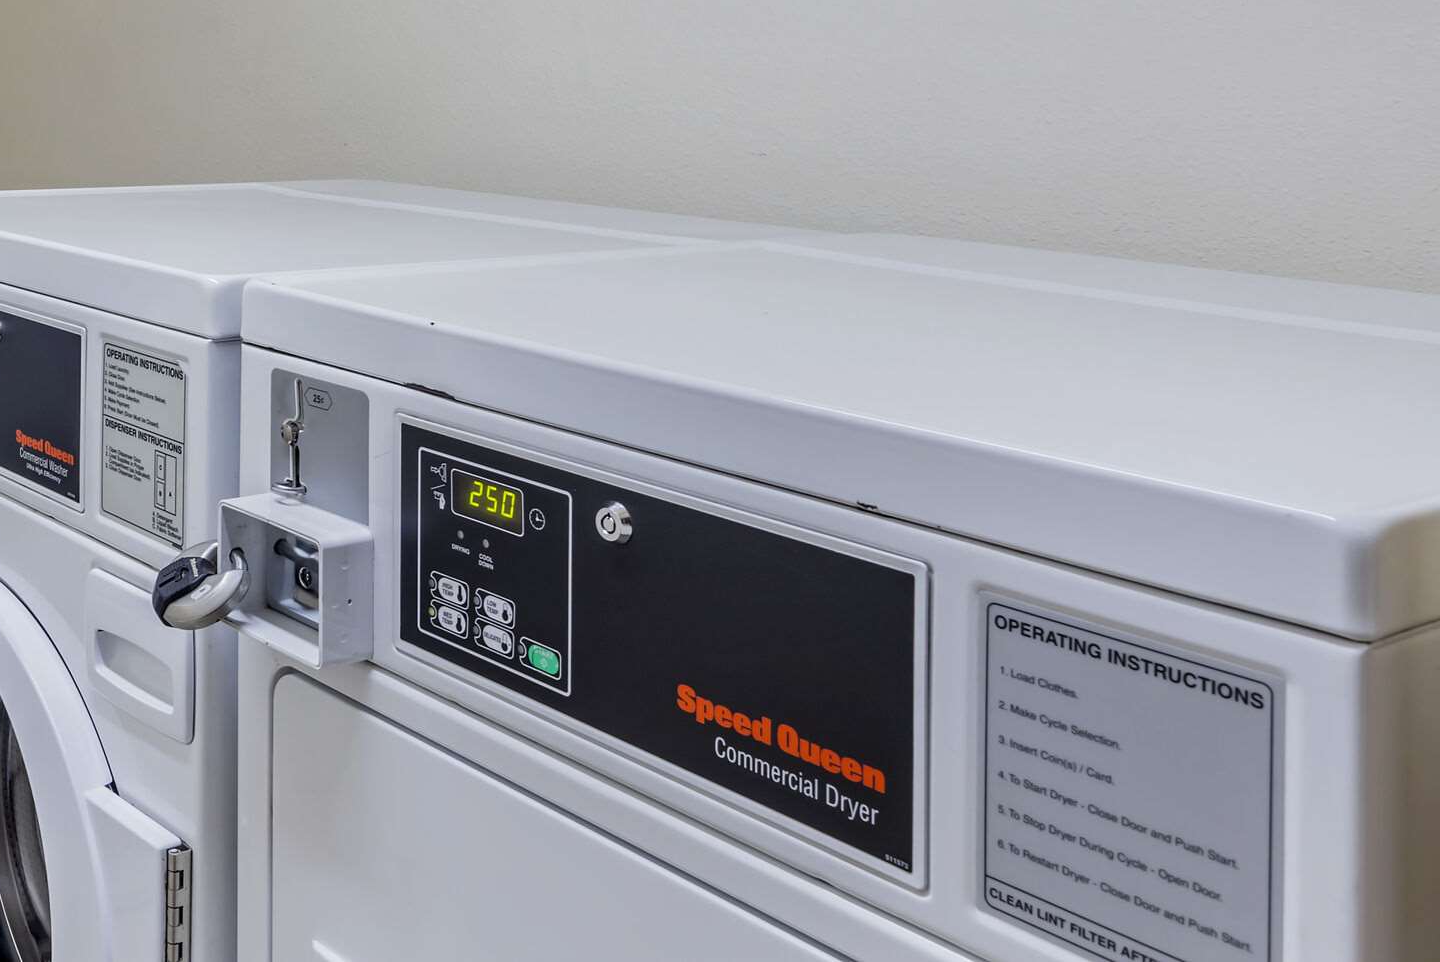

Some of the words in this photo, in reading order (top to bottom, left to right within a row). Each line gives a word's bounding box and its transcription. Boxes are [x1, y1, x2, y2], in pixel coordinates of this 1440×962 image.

[106, 348, 139, 366] OPERATING
[140, 359, 183, 380] INSTRUCTIONS
[15, 429, 44, 453] Speed
[44, 441, 74, 466] Queen
[105, 418, 137, 438] DISPENSER
[138, 430, 182, 454] INSTRUCTIONS
[20, 447, 48, 469] Commercial
[49, 459, 68, 477] Washer
[469, 481, 516, 519] 250
[451, 543, 470, 555] DRYING
[478, 559, 494, 570] DOWN
[479, 553, 493, 563] COOL
[994, 615, 1102, 660] OPERATING
[1108, 648, 1264, 709] INSTRUCTIONS
[1010, 668, 1036, 685] Load
[1038, 678, 1078, 699] Clothes.
[676, 684, 772, 746] Speed
[777, 723, 886, 795] Queen
[1010, 703, 1037, 721] Make
[1039, 714, 1068, 732] Cycle
[1071, 725, 1121, 750] Selection.
[714, 736, 819, 800] Commercial
[825, 783, 879, 826] Dryer
[1010, 738, 1038, 757] Insert
[1040, 749, 1077, 773] Coin(s)
[1086, 766, 1114, 785] Card.
[1009, 772, 1021, 786] To
[1023, 778, 1048, 796] Start
[1049, 789, 1078, 807] Dryer
[1087, 803, 1118, 823] Close
[1121, 815, 1148, 834] Door
[1150, 829, 1172, 844] and
[1175, 836, 1205, 856] Push
[1207, 848, 1240, 870] Start.
[1009, 807, 1021, 821] To
[1023, 813, 1046, 831] Stop
[1048, 824, 1076, 842] Dryer
[1079, 836, 1114, 860] During
[1117, 851, 1148, 872] Cycle
[1158, 868, 1190, 888] Open
[1192, 882, 1223, 902] Door.
[1009, 842, 1021, 856] To
[1022, 850, 1059, 872] Restart
[1061, 865, 1090, 885] Dryer
[1100, 882, 1130, 903] Close
[1133, 895, 1161, 914] Door
[1163, 909, 1185, 926] and
[1188, 918, 1218, 939] Push
[989, 887, 1034, 916] CLEAN
[1037, 907, 1067, 930] LINT
[1070, 922, 1117, 953] FILTER
